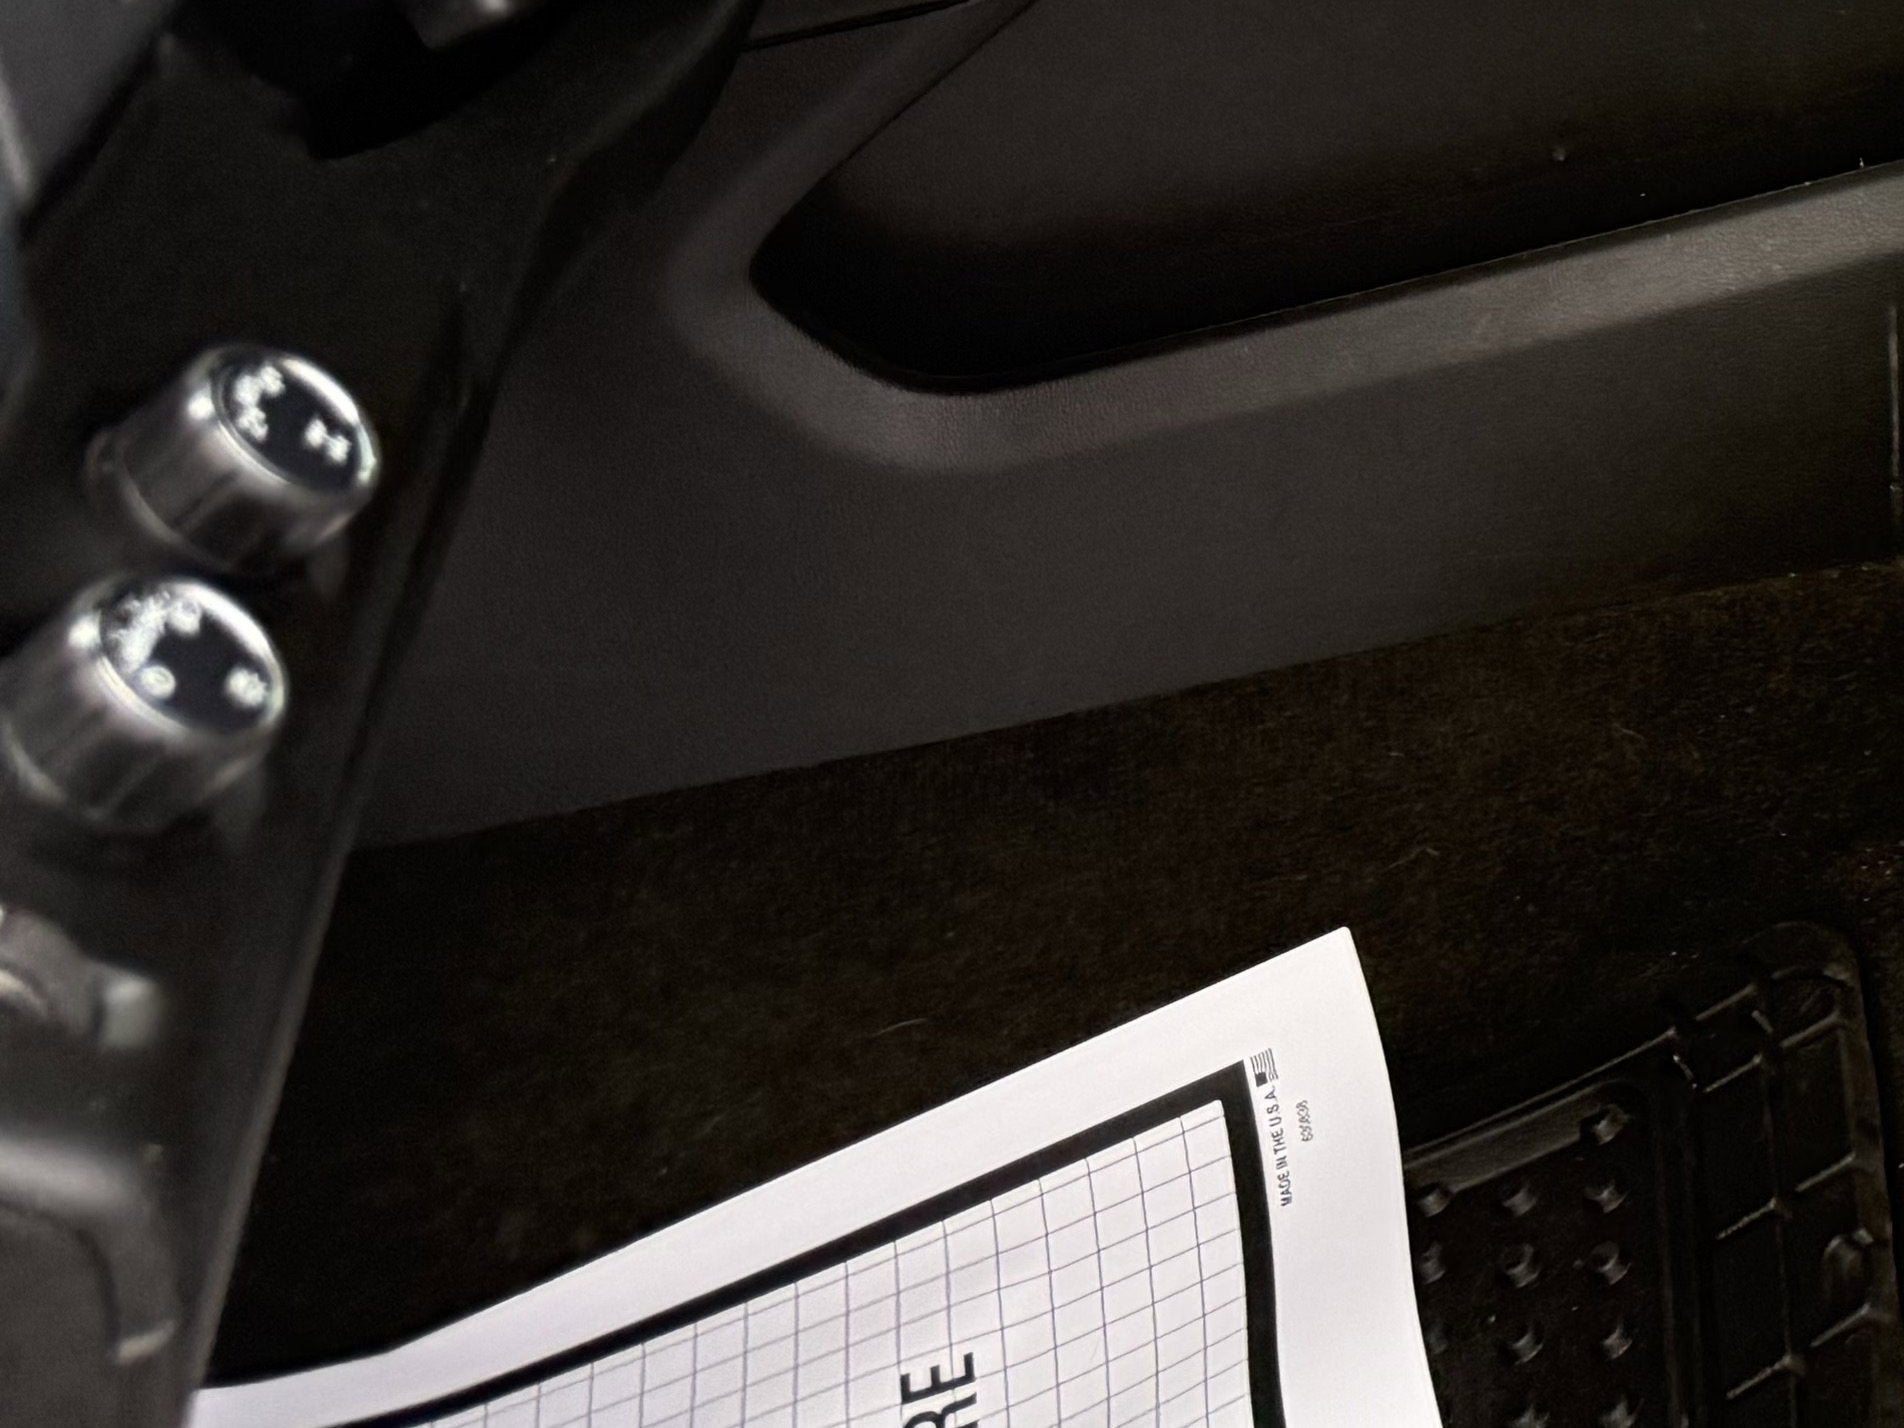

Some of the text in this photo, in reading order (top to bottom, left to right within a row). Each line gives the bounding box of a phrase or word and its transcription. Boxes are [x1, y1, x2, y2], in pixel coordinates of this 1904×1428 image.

[1271, 1127, 1287, 1155] THE
[1276, 1156, 1288, 1170] IN
[1277, 1170, 1292, 1206] MADE
